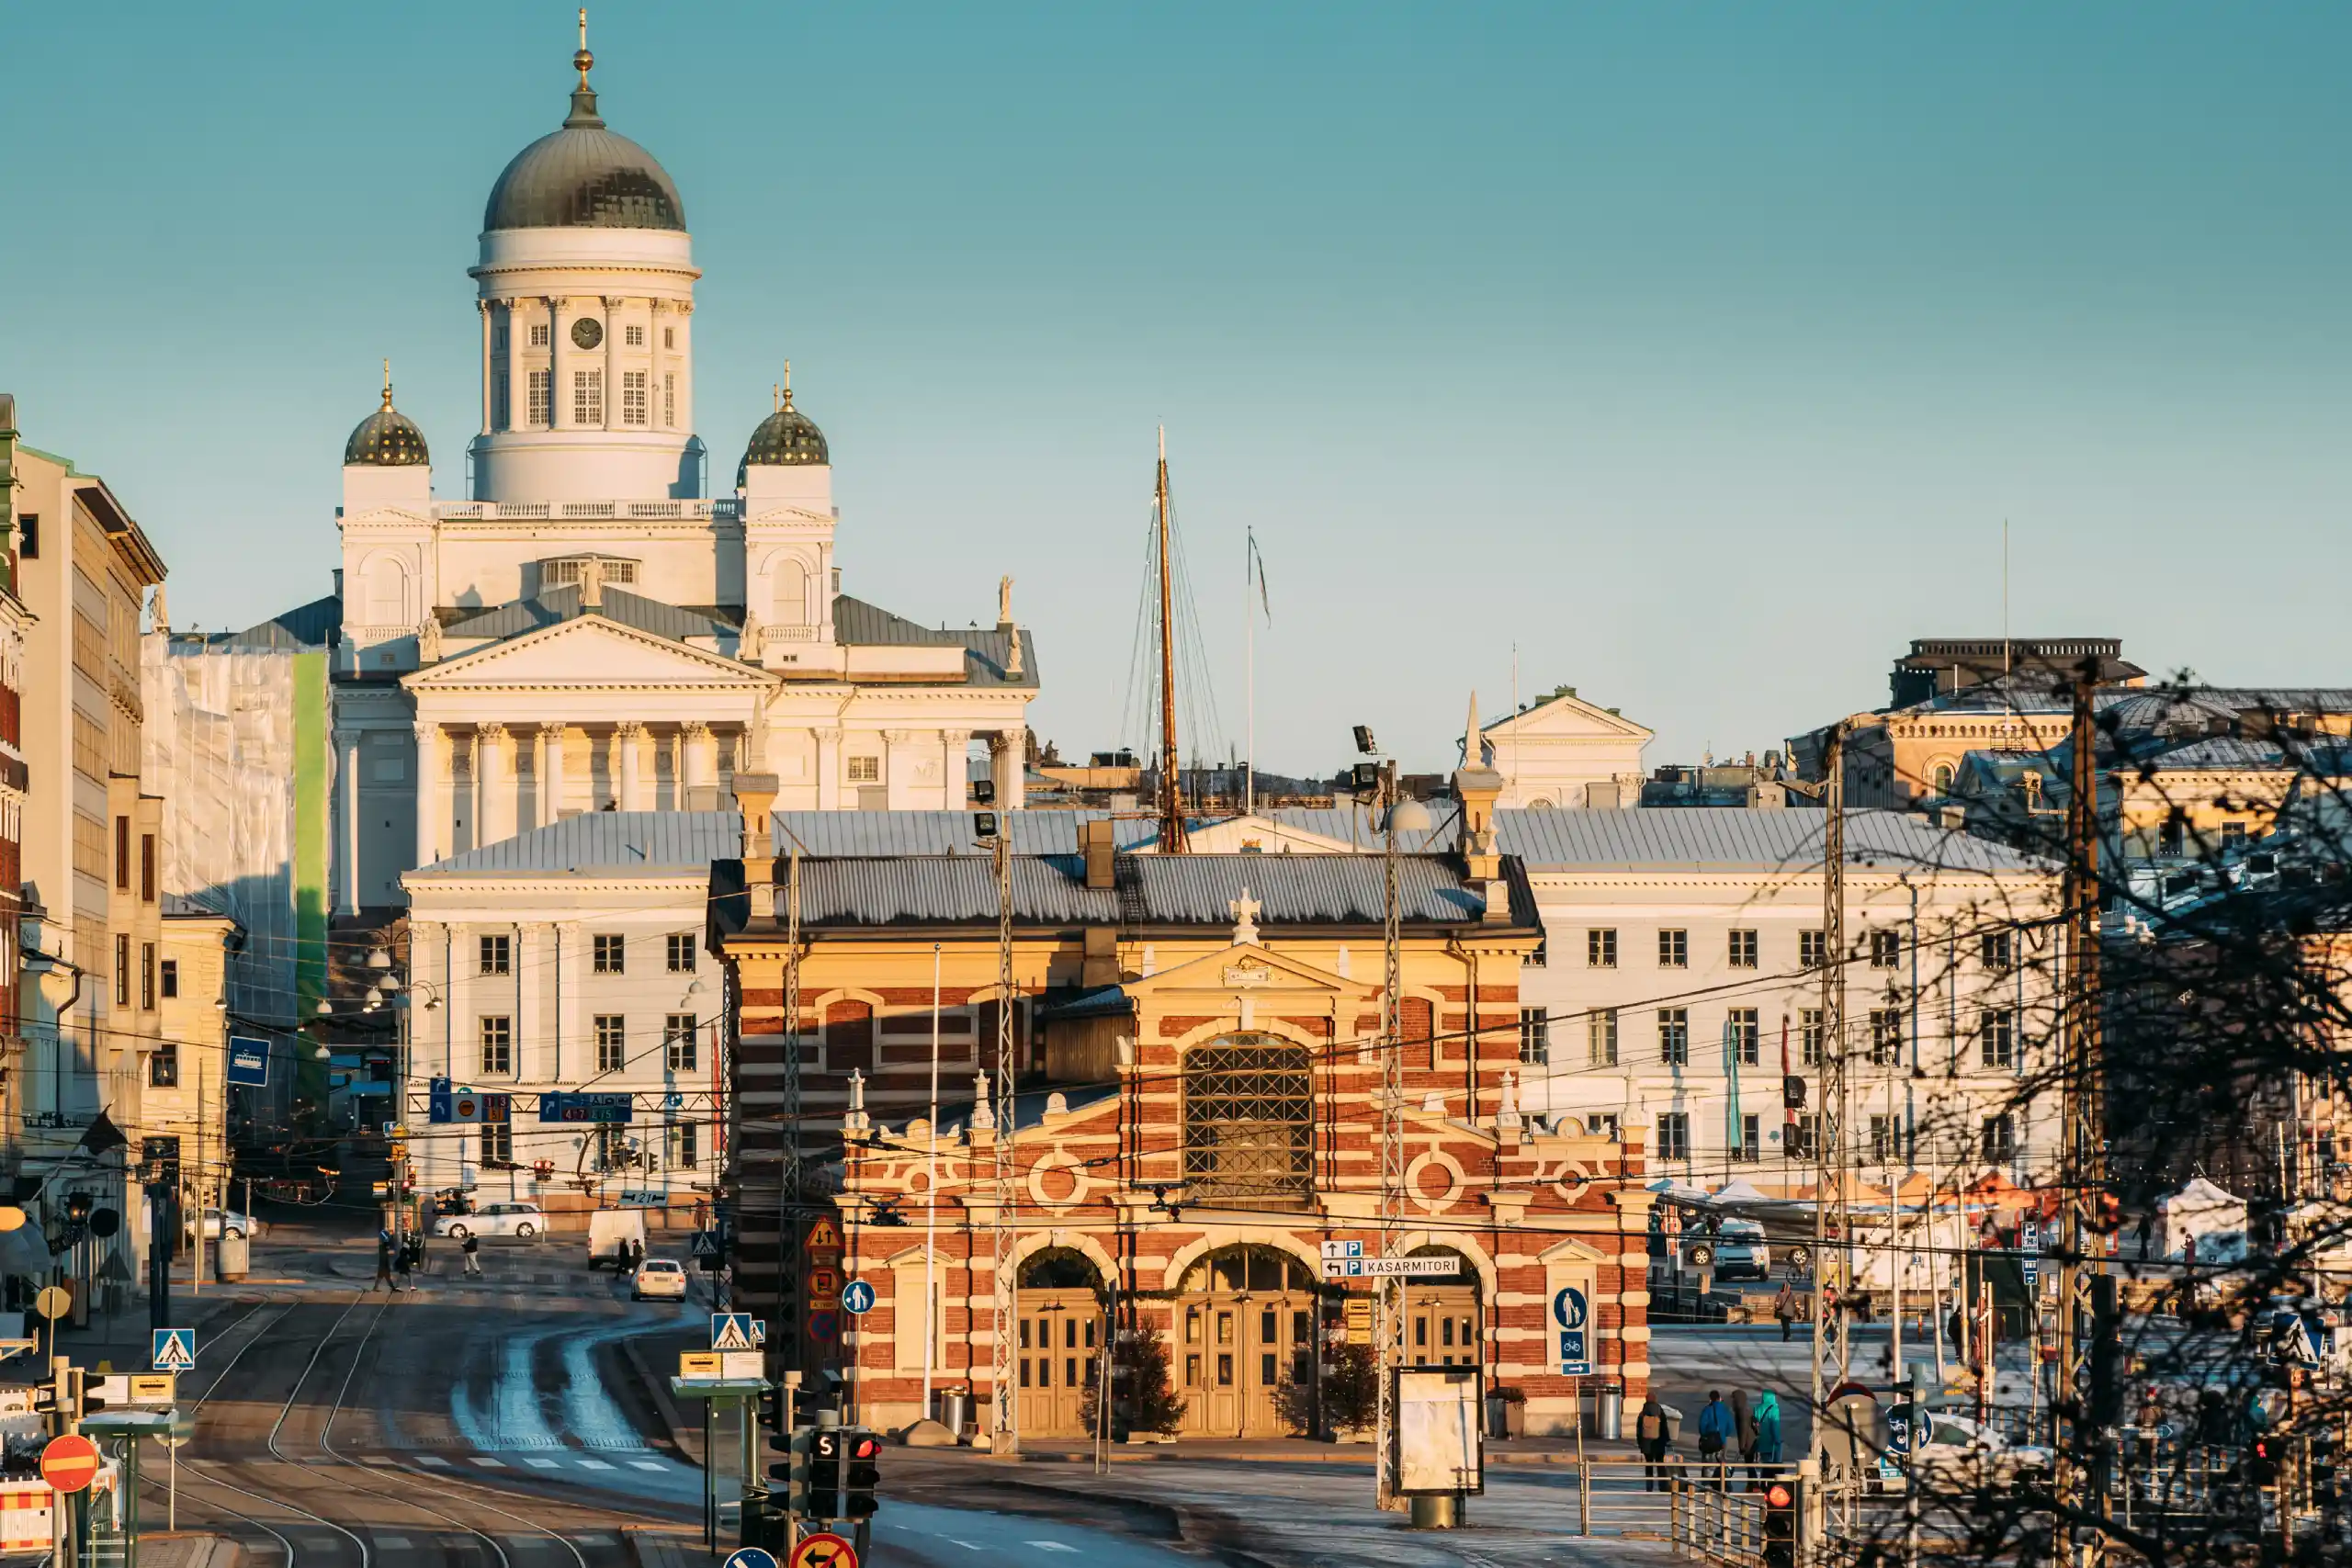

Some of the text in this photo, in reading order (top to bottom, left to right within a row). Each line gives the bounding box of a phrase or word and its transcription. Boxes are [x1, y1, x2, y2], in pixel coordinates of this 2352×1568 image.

[2025, 1223, 2035, 1236] P
[1349, 1243, 1359, 1256] P
[1349, 1260, 1456, 1275] P KASARMITORI
[819, 1436, 833, 1455] S
